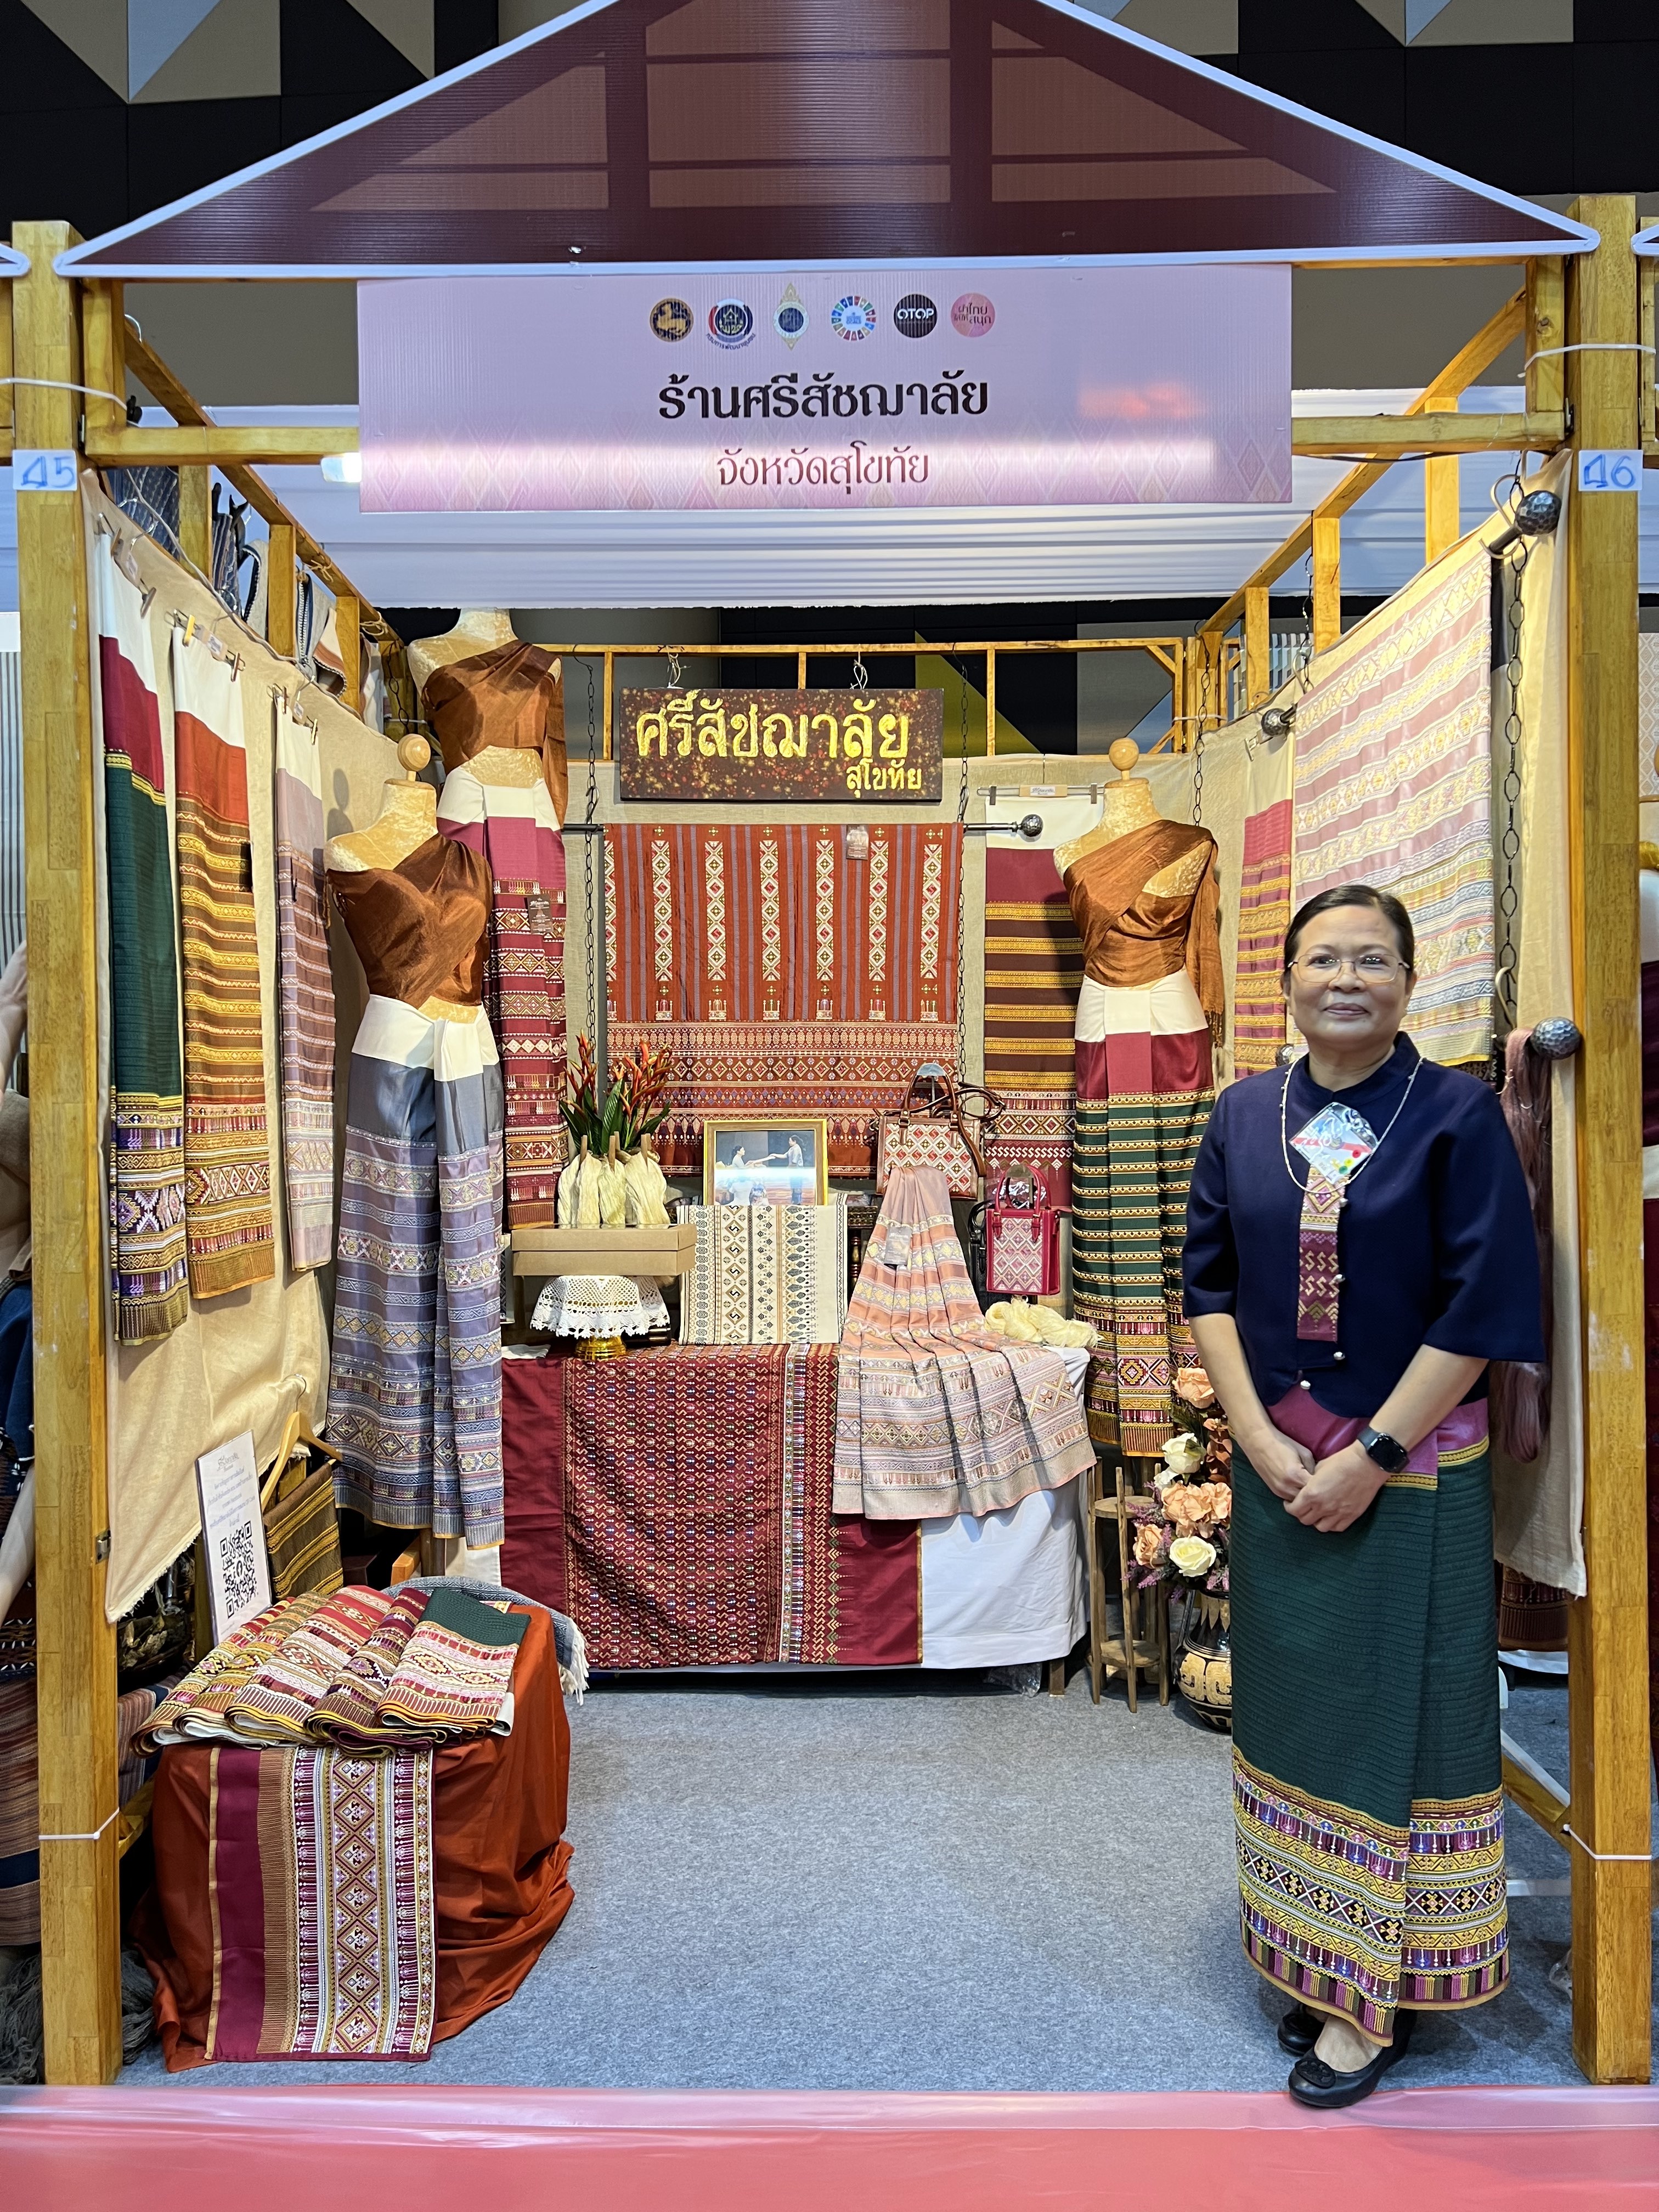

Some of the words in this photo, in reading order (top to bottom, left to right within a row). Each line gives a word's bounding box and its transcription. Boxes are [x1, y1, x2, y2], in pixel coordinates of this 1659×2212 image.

[897, 308, 934, 320] OTOP
[21, 456, 75, 488] 45
[716, 440, 929, 494] จังหวัดสุโขทัย
[1584, 454, 1636, 488] 46
[846, 758, 922, 799] สุโขทัย
